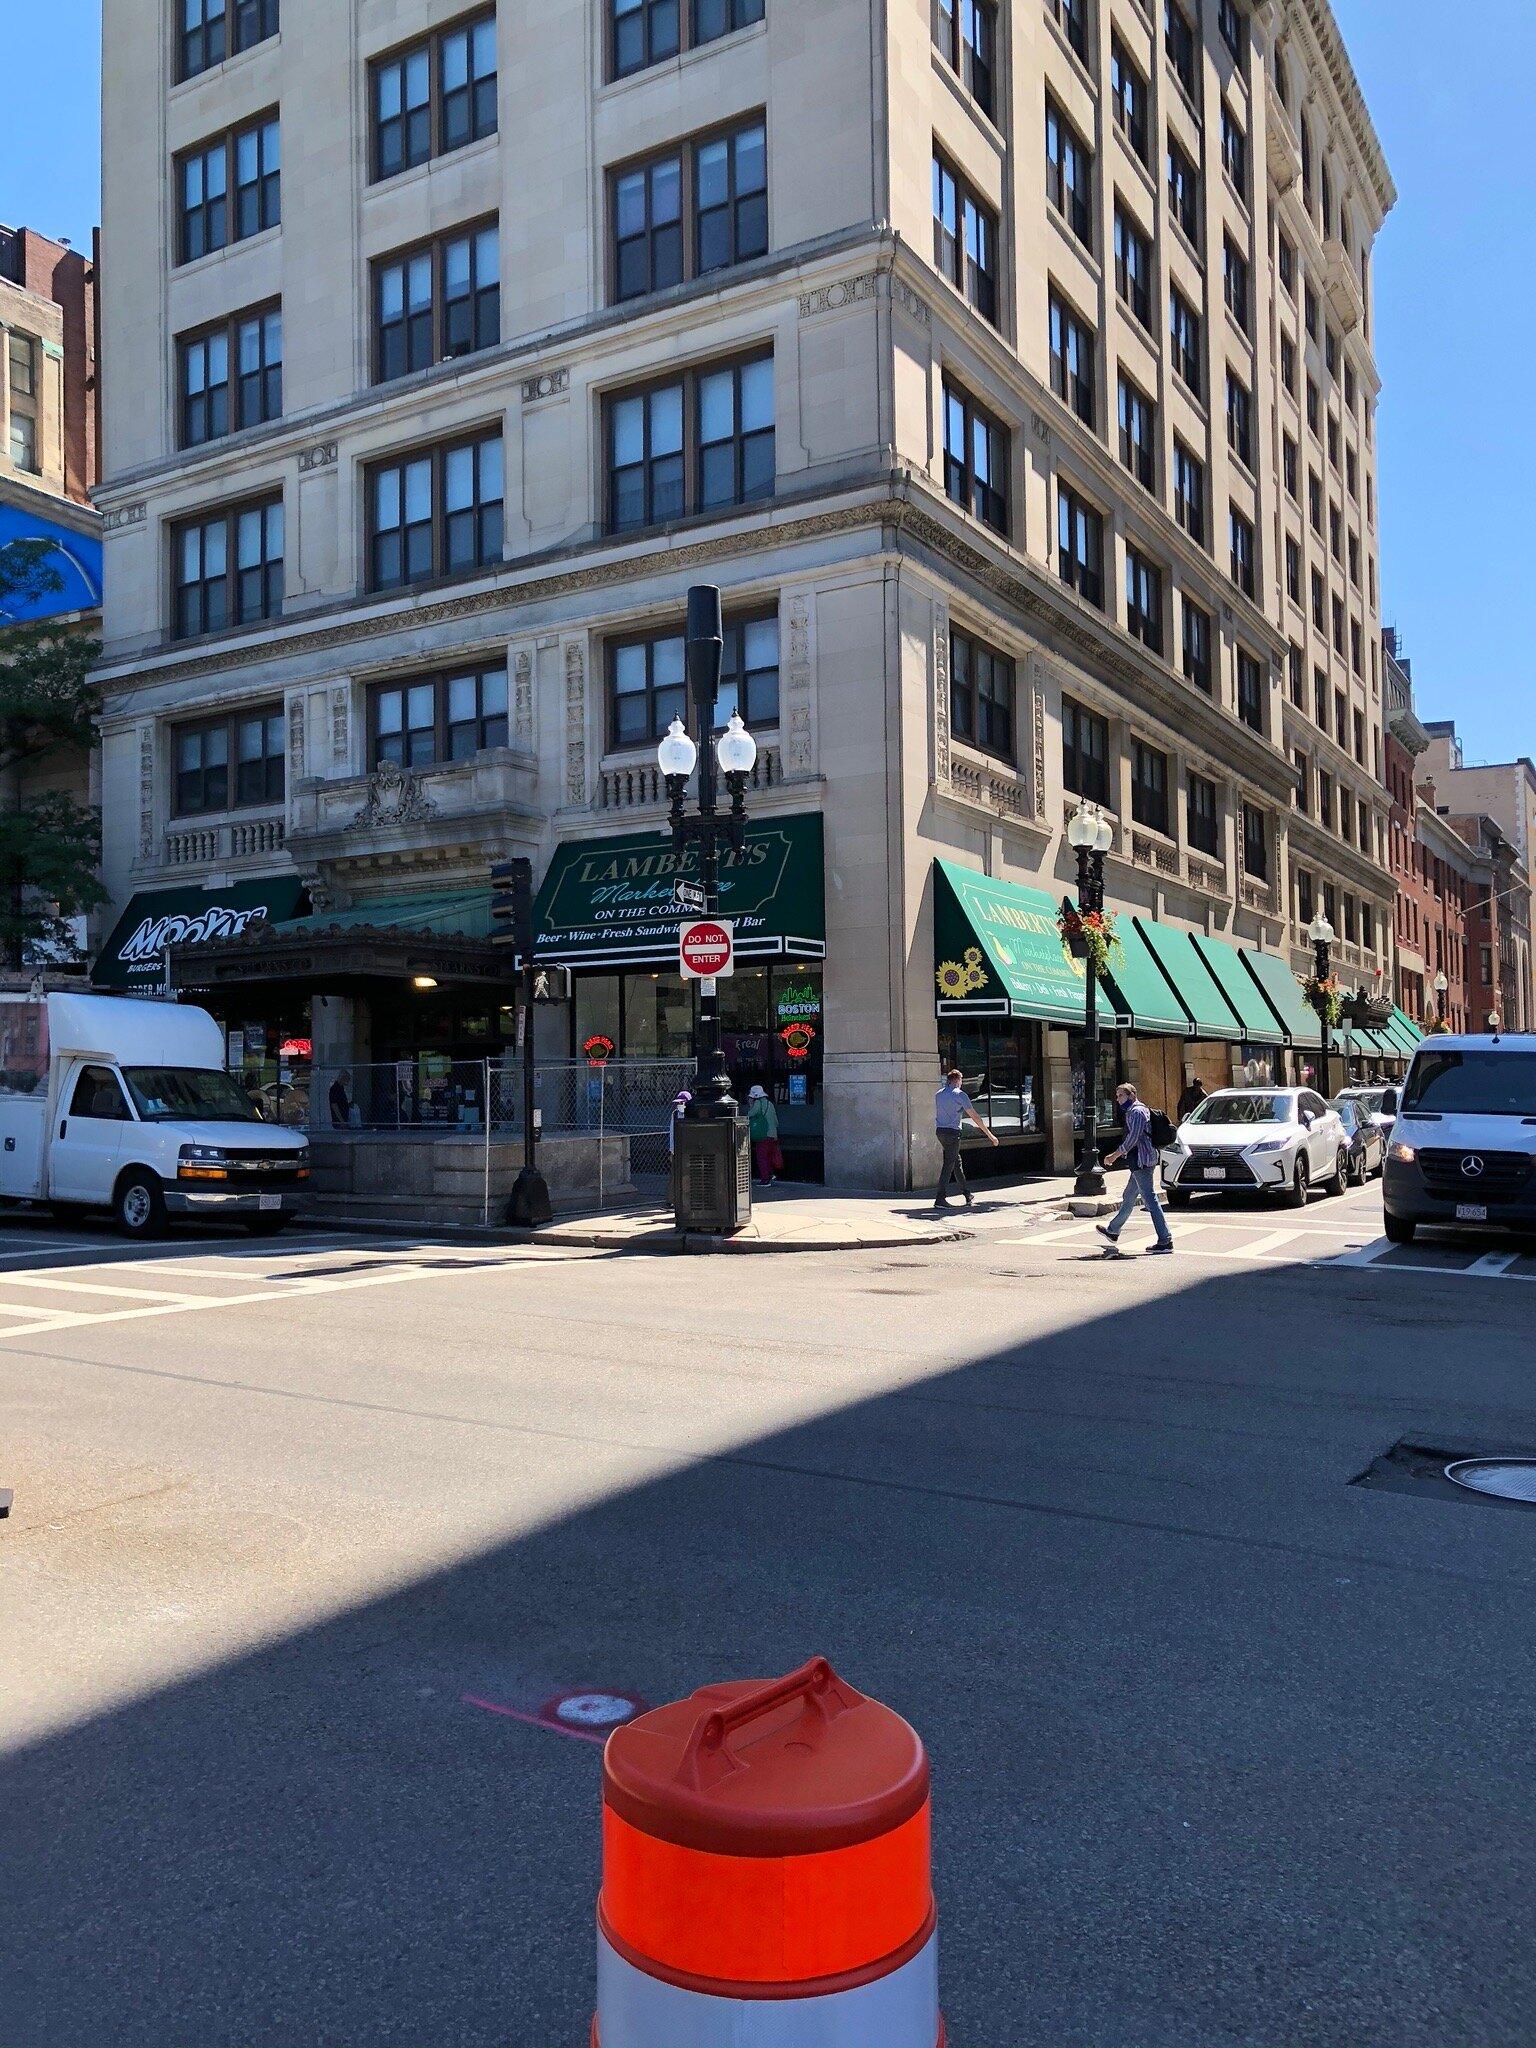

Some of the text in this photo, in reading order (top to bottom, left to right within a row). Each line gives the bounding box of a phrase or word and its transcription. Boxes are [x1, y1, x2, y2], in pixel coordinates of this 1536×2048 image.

[594, 903, 694, 920] ON THE COMM
[536, 933, 562, 943] Beer
[569, 930, 597, 941] Wine
[601, 927, 633, 939] Fresh
[742, 916, 766, 928] Bar
[688, 934, 724, 944] DO NOT
[692, 954, 721, 964] ENTER
[127, 962, 163, 974] BURGERS
[778, 1003, 820, 1015] BOSTON
